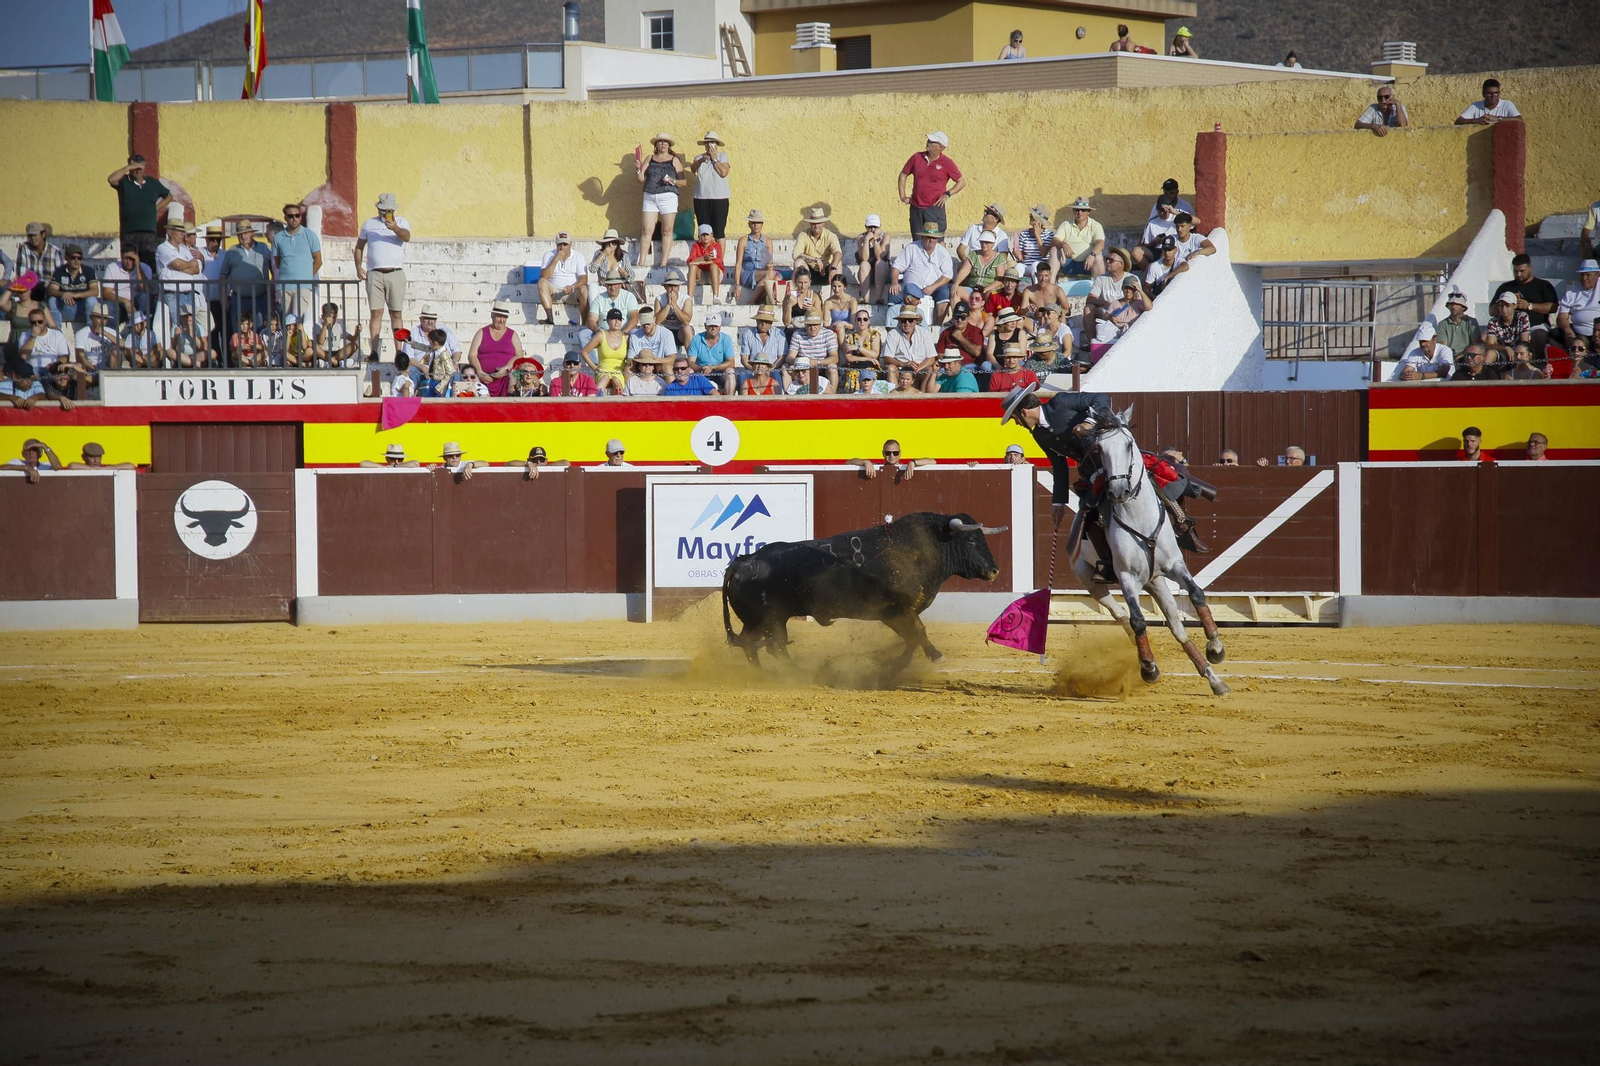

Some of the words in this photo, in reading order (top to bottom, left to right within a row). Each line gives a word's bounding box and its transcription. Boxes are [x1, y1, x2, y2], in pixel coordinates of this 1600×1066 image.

[154, 378, 307, 401] TORILES
[706, 430, 723, 452] 4
[687, 569, 719, 578] OBRAS
